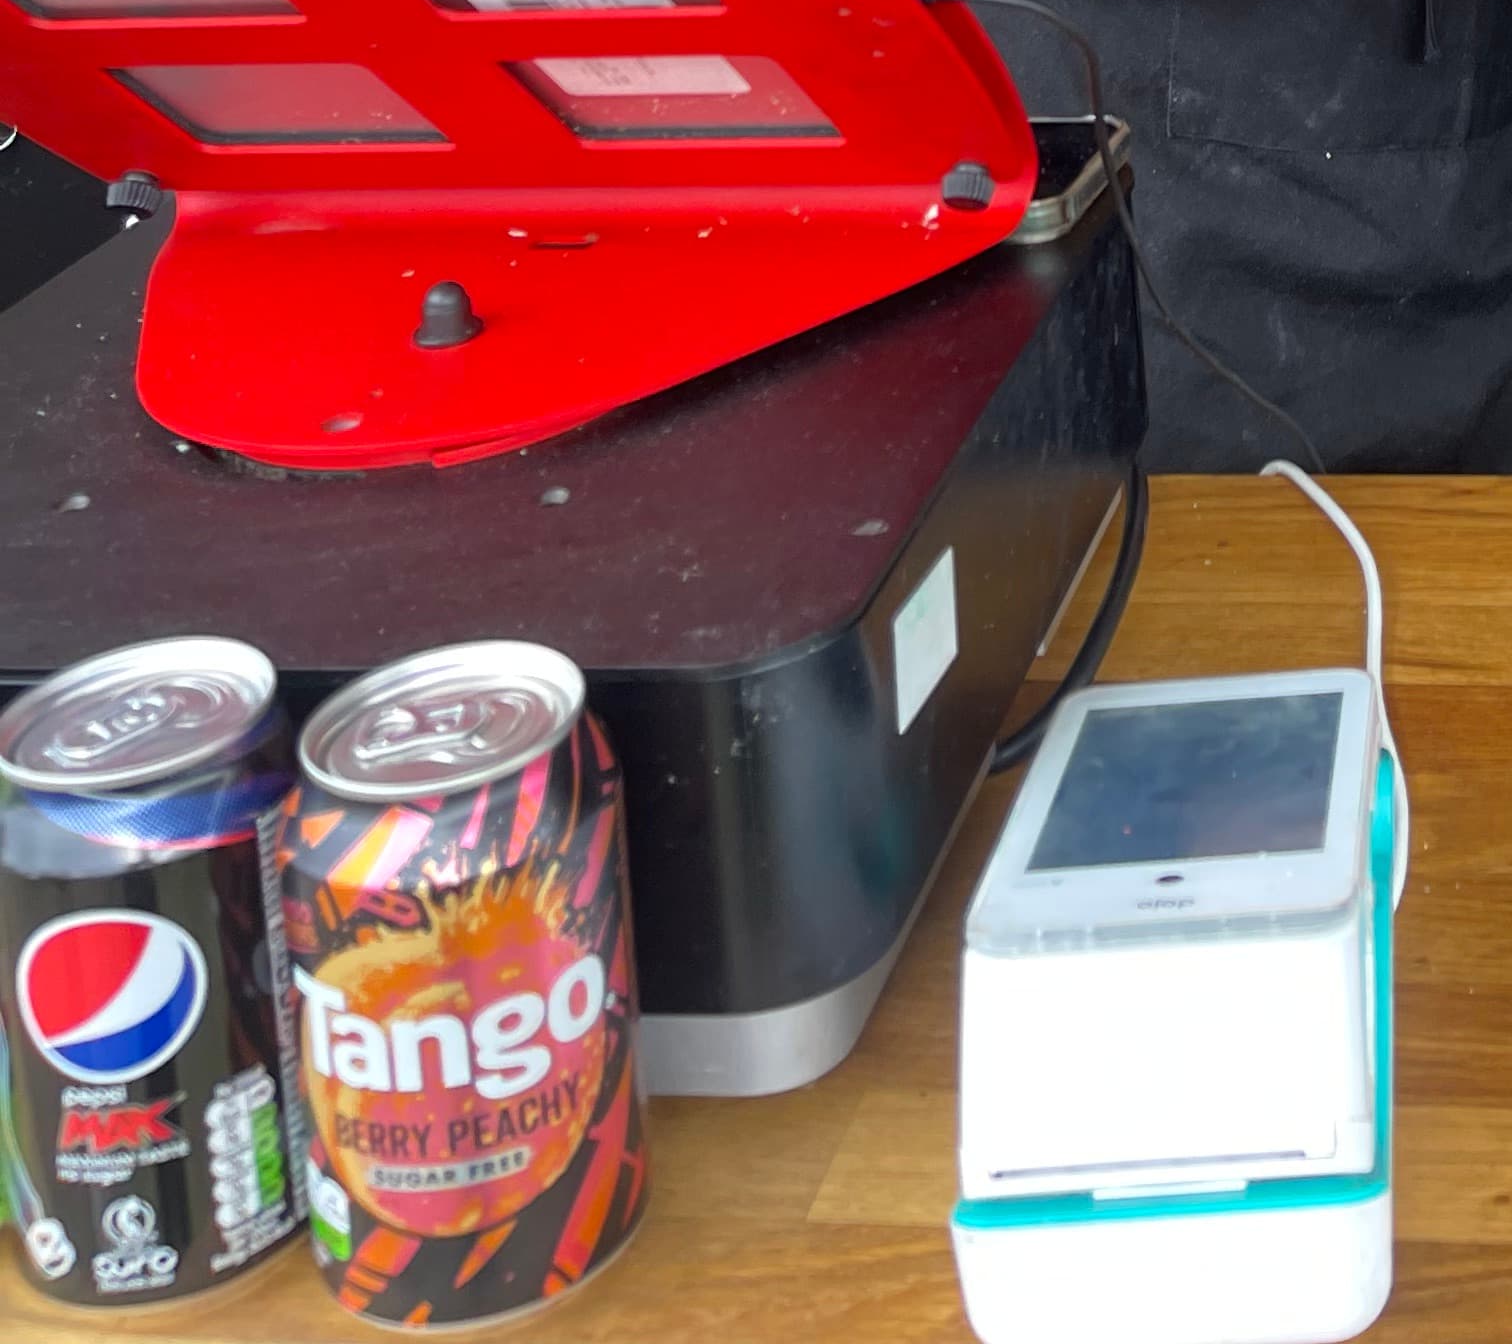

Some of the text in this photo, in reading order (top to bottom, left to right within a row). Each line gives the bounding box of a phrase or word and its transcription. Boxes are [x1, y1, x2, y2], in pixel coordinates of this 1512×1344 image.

[293, 953, 605, 1100] Tango
[336, 1070, 582, 1160] BERRY PEACHY
[371, 1150, 526, 1189] SUGAR FREE
